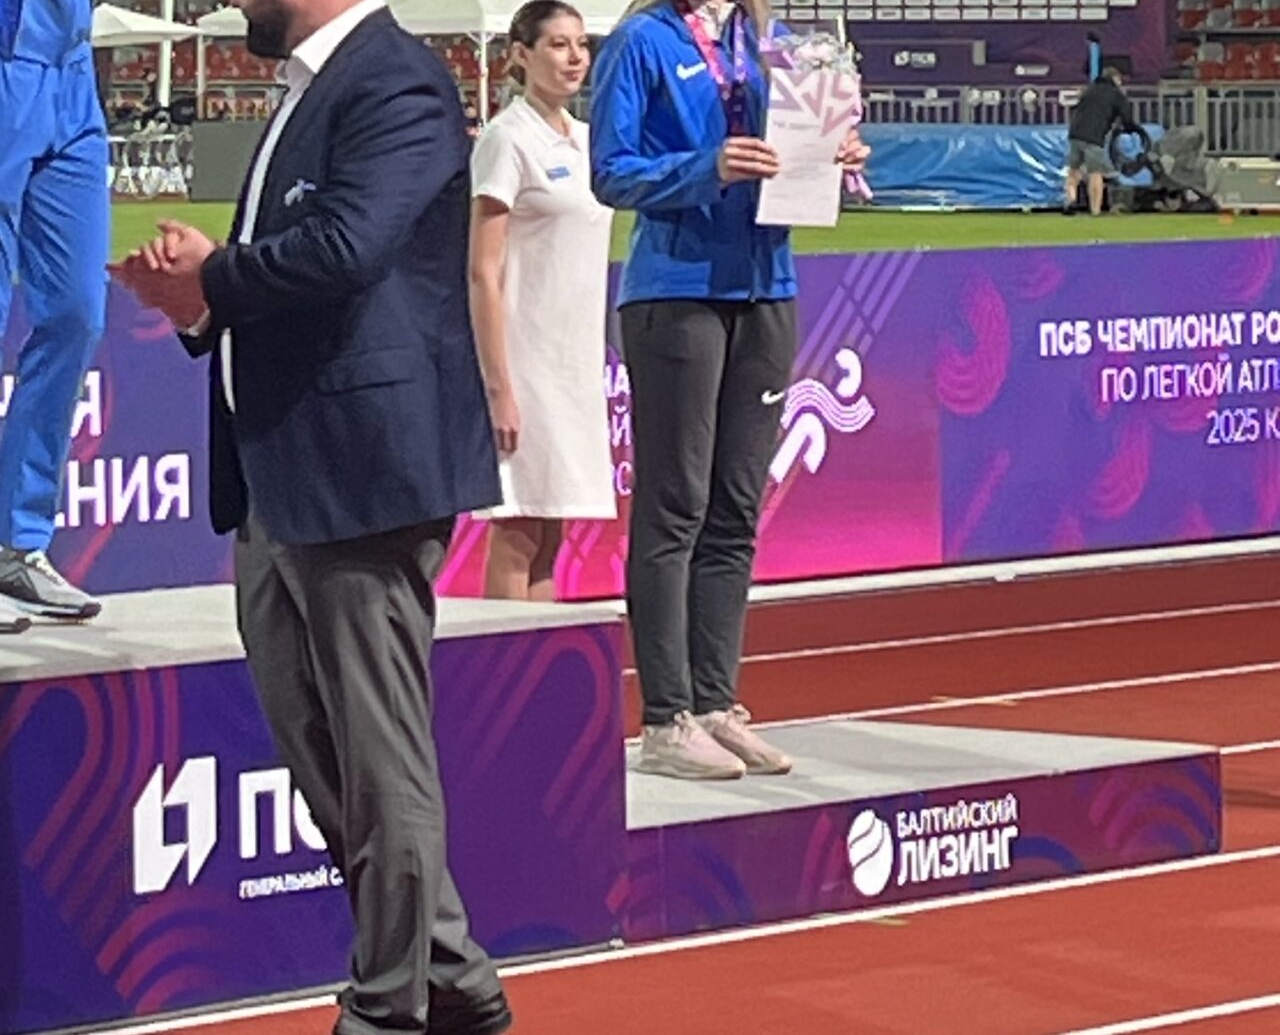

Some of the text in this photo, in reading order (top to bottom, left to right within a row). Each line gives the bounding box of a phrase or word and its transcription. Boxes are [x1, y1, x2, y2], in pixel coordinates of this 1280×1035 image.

[1040, 320, 1092, 356] ПСБ
[1098, 312, 1246, 352] ЧЕМПИОНАТ
[1102, 366, 1137, 402] ПО
[1141, 352, 1232, 401] ЛЕГКОЙ
[1206, 408, 1260, 444] 2025
[896, 793, 1018, 839] БАЛТИЙСКИЙ
[897, 825, 1019, 886] ЛИЗИНГ
